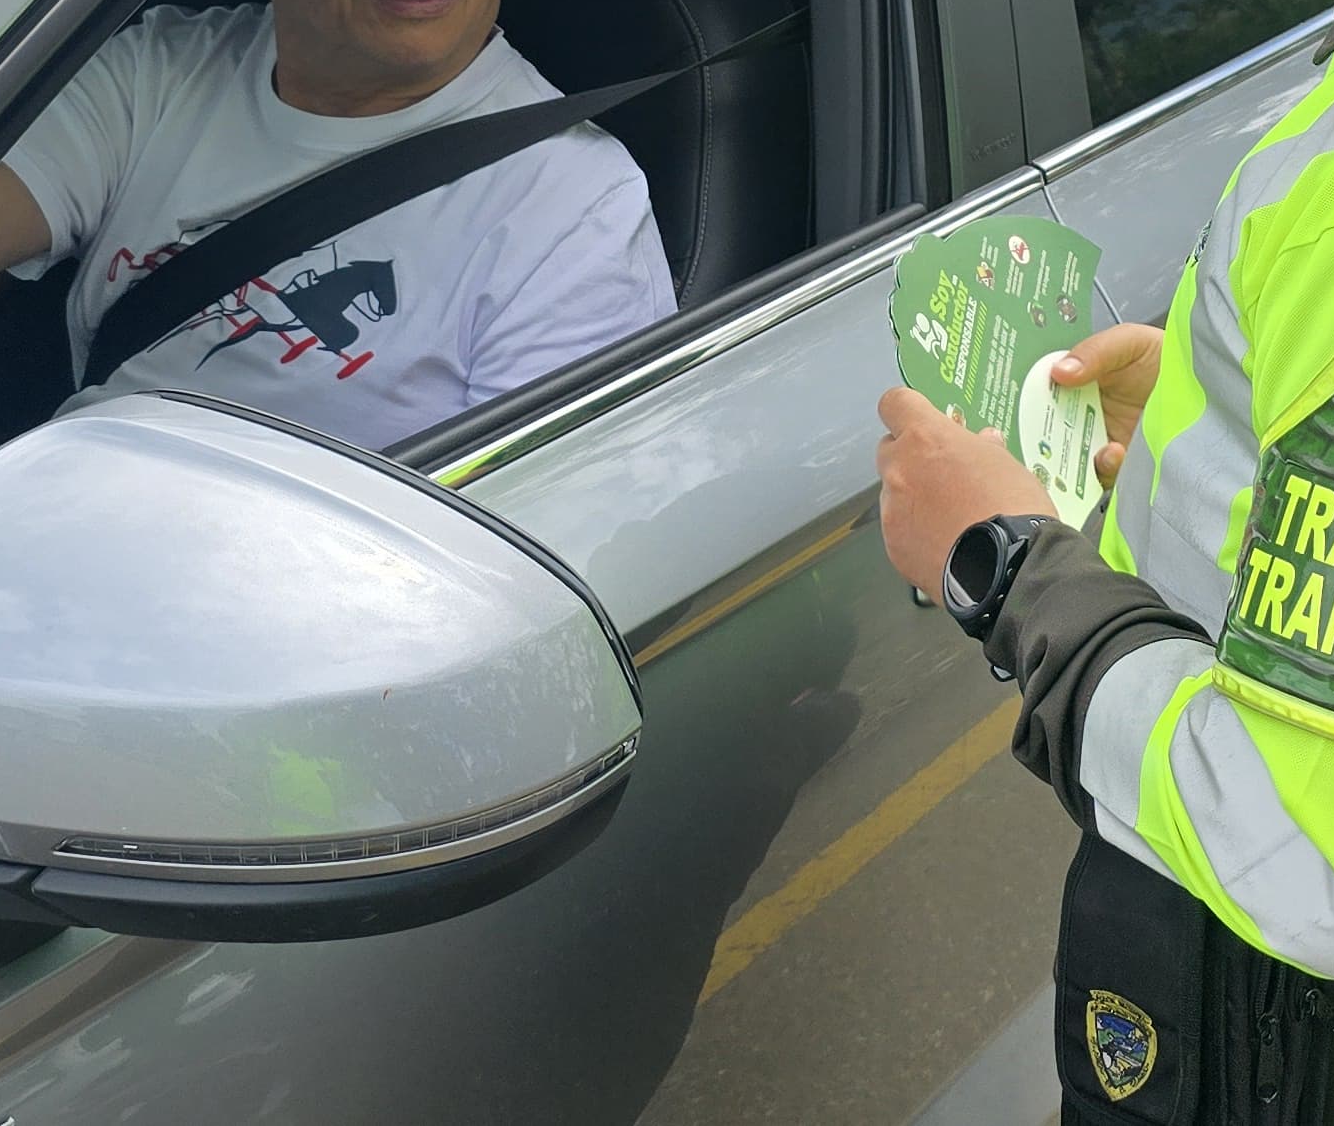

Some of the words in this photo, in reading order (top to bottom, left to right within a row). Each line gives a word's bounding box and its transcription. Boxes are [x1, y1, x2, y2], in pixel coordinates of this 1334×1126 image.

[929, 268, 956, 322] Soy
[939, 279, 969, 385] Conductor
[954, 295, 977, 389] RESPONSABLE
